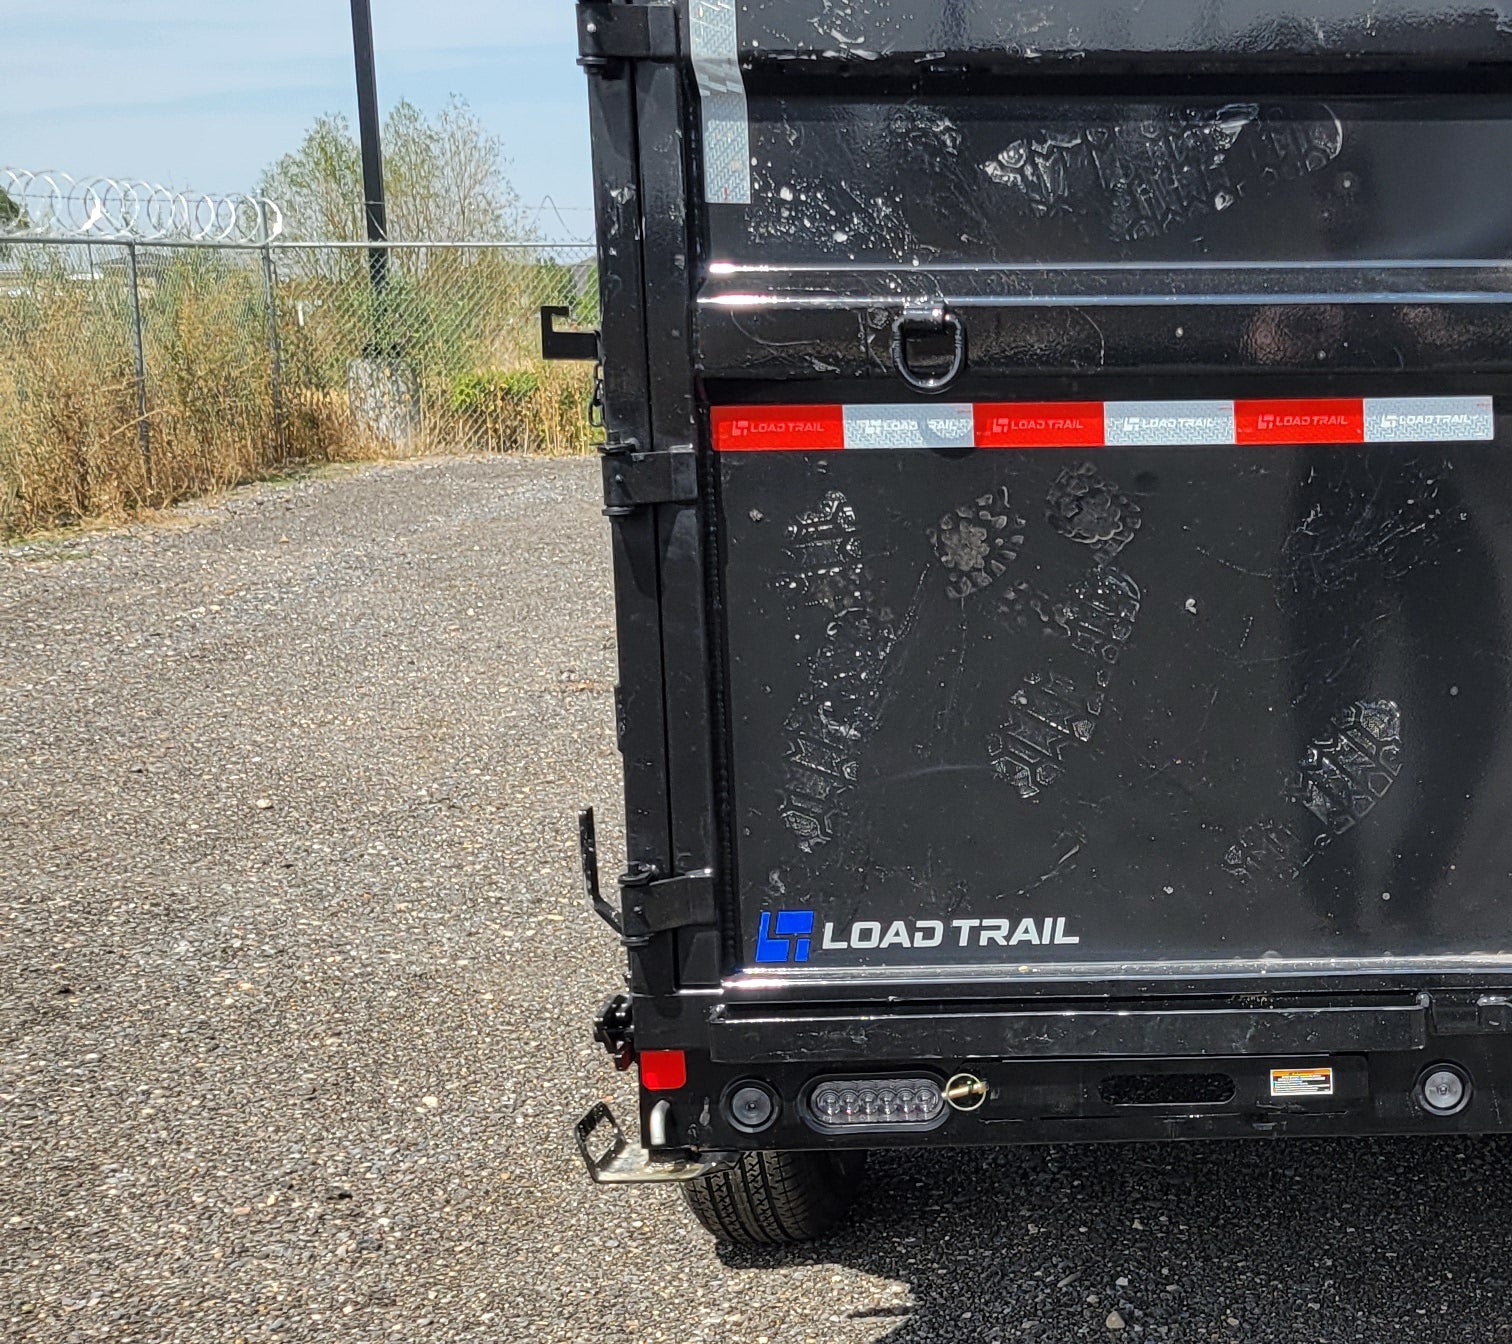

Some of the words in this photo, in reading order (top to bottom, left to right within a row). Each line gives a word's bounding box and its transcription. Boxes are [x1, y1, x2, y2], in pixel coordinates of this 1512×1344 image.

[883, 419, 919, 431] LOAD
[1011, 418, 1045, 430] LOAD
[1047, 418, 1084, 429] TRAIL
[1140, 418, 1177, 429] LOAD
[1178, 417, 1215, 428] TRAIL
[1276, 416, 1311, 427] LOAD
[1311, 415, 1349, 426] TRAIL
[1398, 415, 1434, 426] LOAD
[1435, 414, 1471, 425] TRAIL
[750, 421, 785, 433] LOAD
[787, 421, 825, 432] TRAIL
[821, 920, 944, 950] LOAD
[951, 917, 1080, 947] TRAIL
